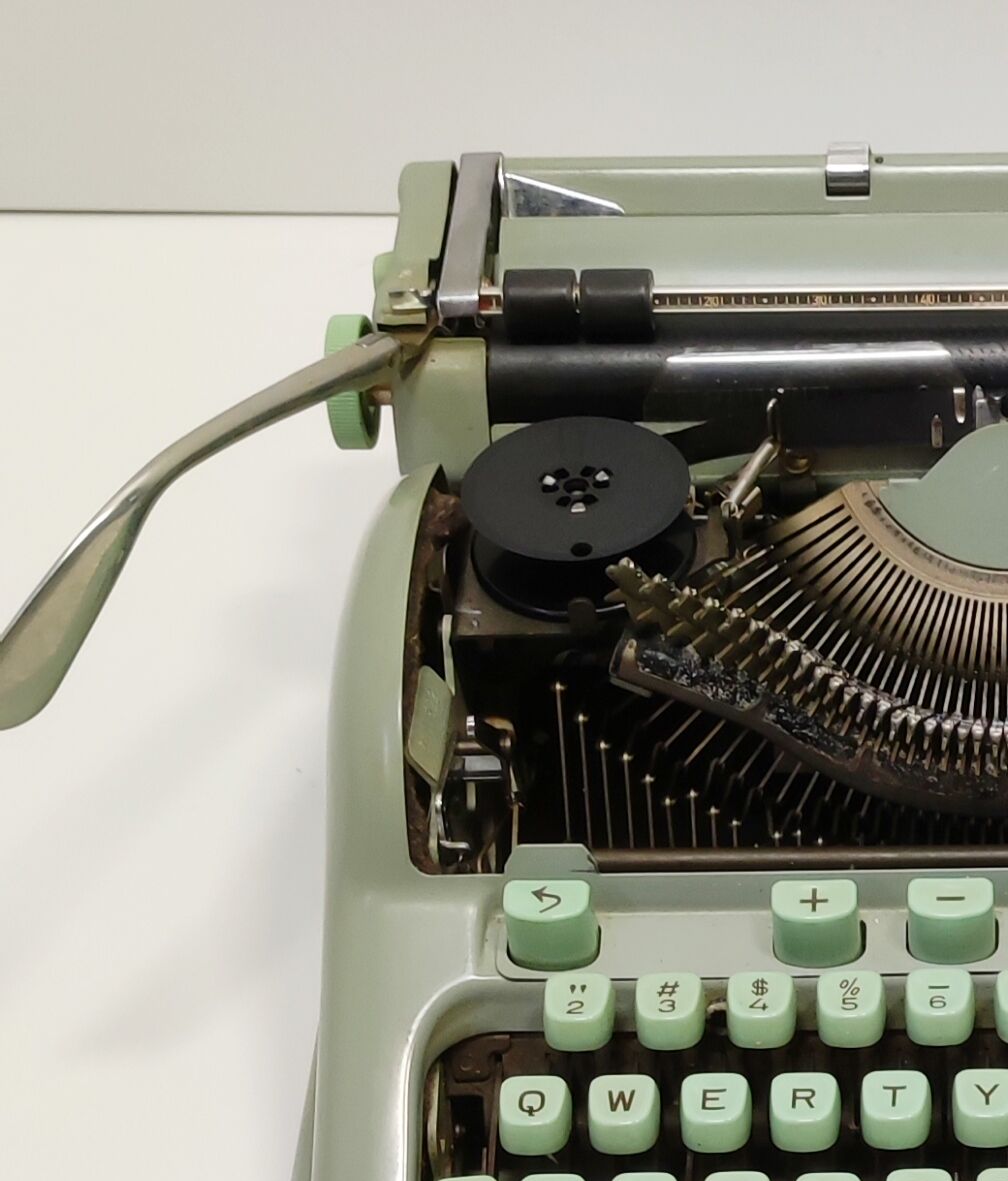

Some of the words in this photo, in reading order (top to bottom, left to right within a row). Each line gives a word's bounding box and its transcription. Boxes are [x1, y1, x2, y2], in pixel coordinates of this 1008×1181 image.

[751, 976, 769, 997] $
[565, 1000, 585, 1015] 2
[658, 998, 676, 1013] 3
[748, 997, 769, 1012] 4
[840, 997, 859, 1012] 5
[929, 995, 947, 1009] 6
[518, 1090, 546, 1117] Q
[607, 1089, 636, 1113] W
[701, 1088, 727, 1111] E
[791, 1088, 816, 1109] R
[882, 1085, 907, 1108] T
[974, 1083, 1000, 1106] Y
